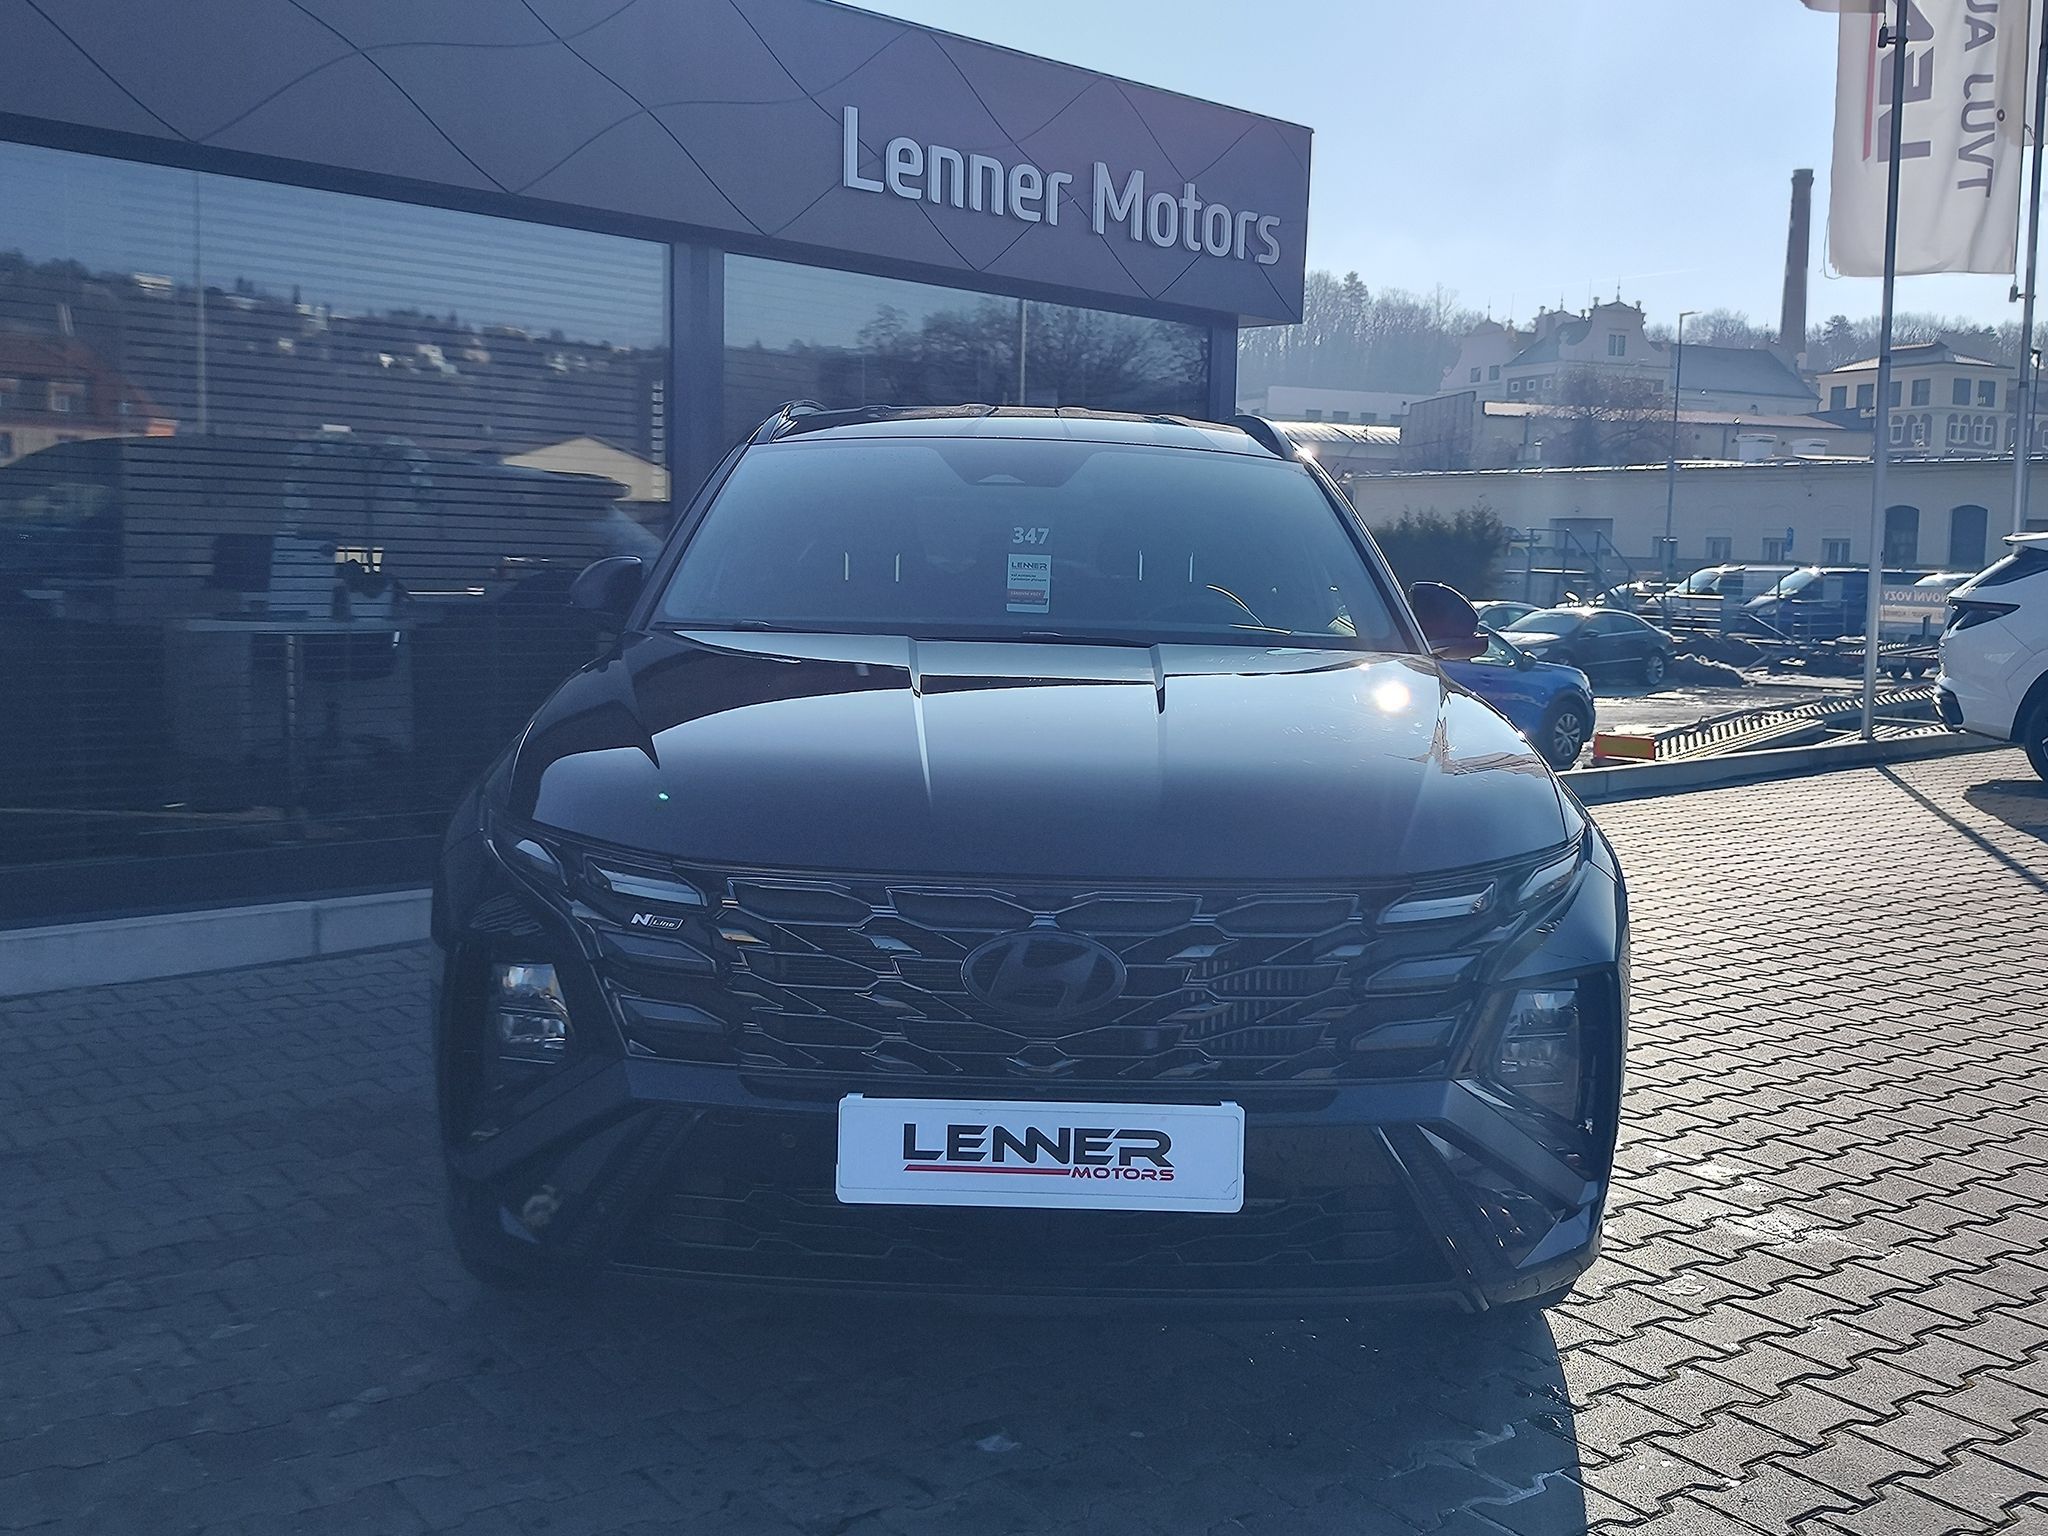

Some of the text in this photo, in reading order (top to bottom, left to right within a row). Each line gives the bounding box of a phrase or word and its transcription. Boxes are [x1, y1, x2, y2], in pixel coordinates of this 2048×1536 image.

[843, 105, 1281, 265] Lenner Motors
[1012, 526, 1050, 545] 347
[1011, 561, 1048, 571] LENNER
[631, 913, 675, 927] N Line
[903, 1123, 1175, 1166] LENNER
[1071, 1166, 1175, 1181] MOTORS
